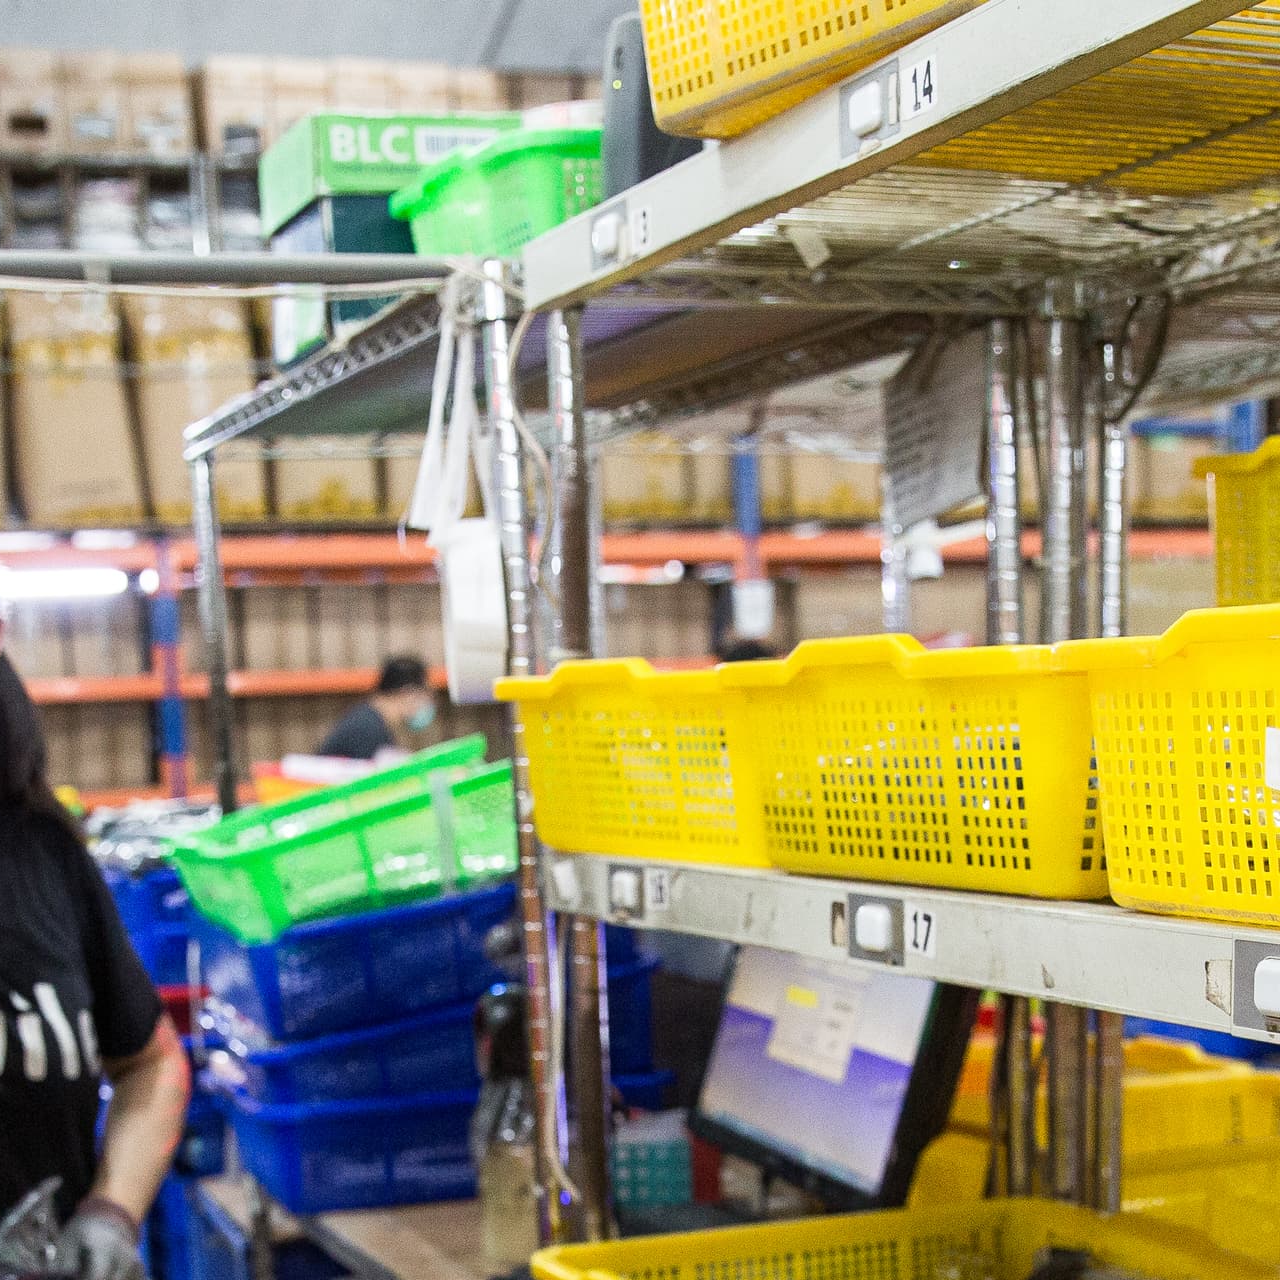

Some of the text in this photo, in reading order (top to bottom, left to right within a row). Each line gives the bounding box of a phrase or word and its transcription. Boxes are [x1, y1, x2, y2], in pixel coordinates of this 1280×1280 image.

[911, 59, 934, 111] 14
[329, 123, 411, 164] BLC
[912, 911, 933, 952] 17
